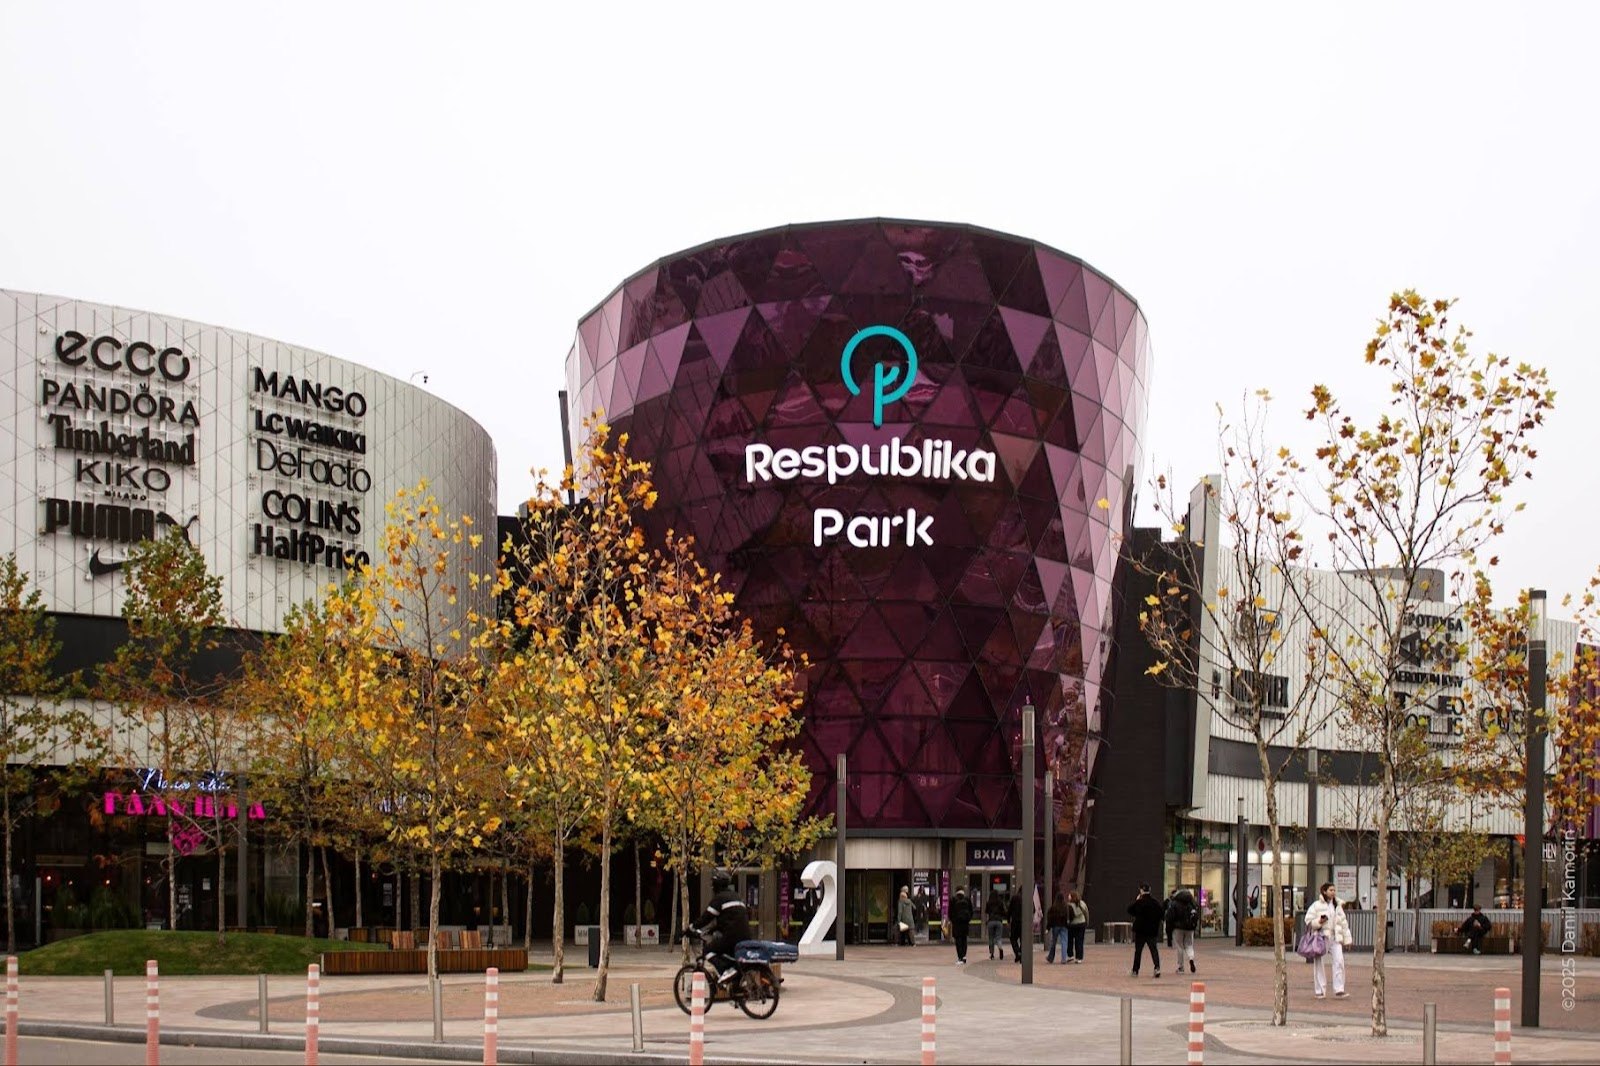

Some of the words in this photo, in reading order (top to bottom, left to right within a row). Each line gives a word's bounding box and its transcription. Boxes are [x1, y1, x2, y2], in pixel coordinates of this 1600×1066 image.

[55, 330, 191, 382] ecco
[42, 378, 200, 427] PANDORA
[254, 366, 367, 418] MANGO
[48, 413, 195, 466] Timberland
[745, 436, 996, 485] Respublika
[77, 458, 171, 492] KIKO
[256, 438, 372, 493] DeFacto
[46, 497, 154, 543] PUMA
[104, 490, 147, 501] MILANO
[262, 489, 361, 535] COLIN'S
[254, 523, 370, 573] HalfPrice
[813, 508, 935, 548] Park
[974, 849, 1006, 861] ВХІД
[798, 860, 838, 955] 2
